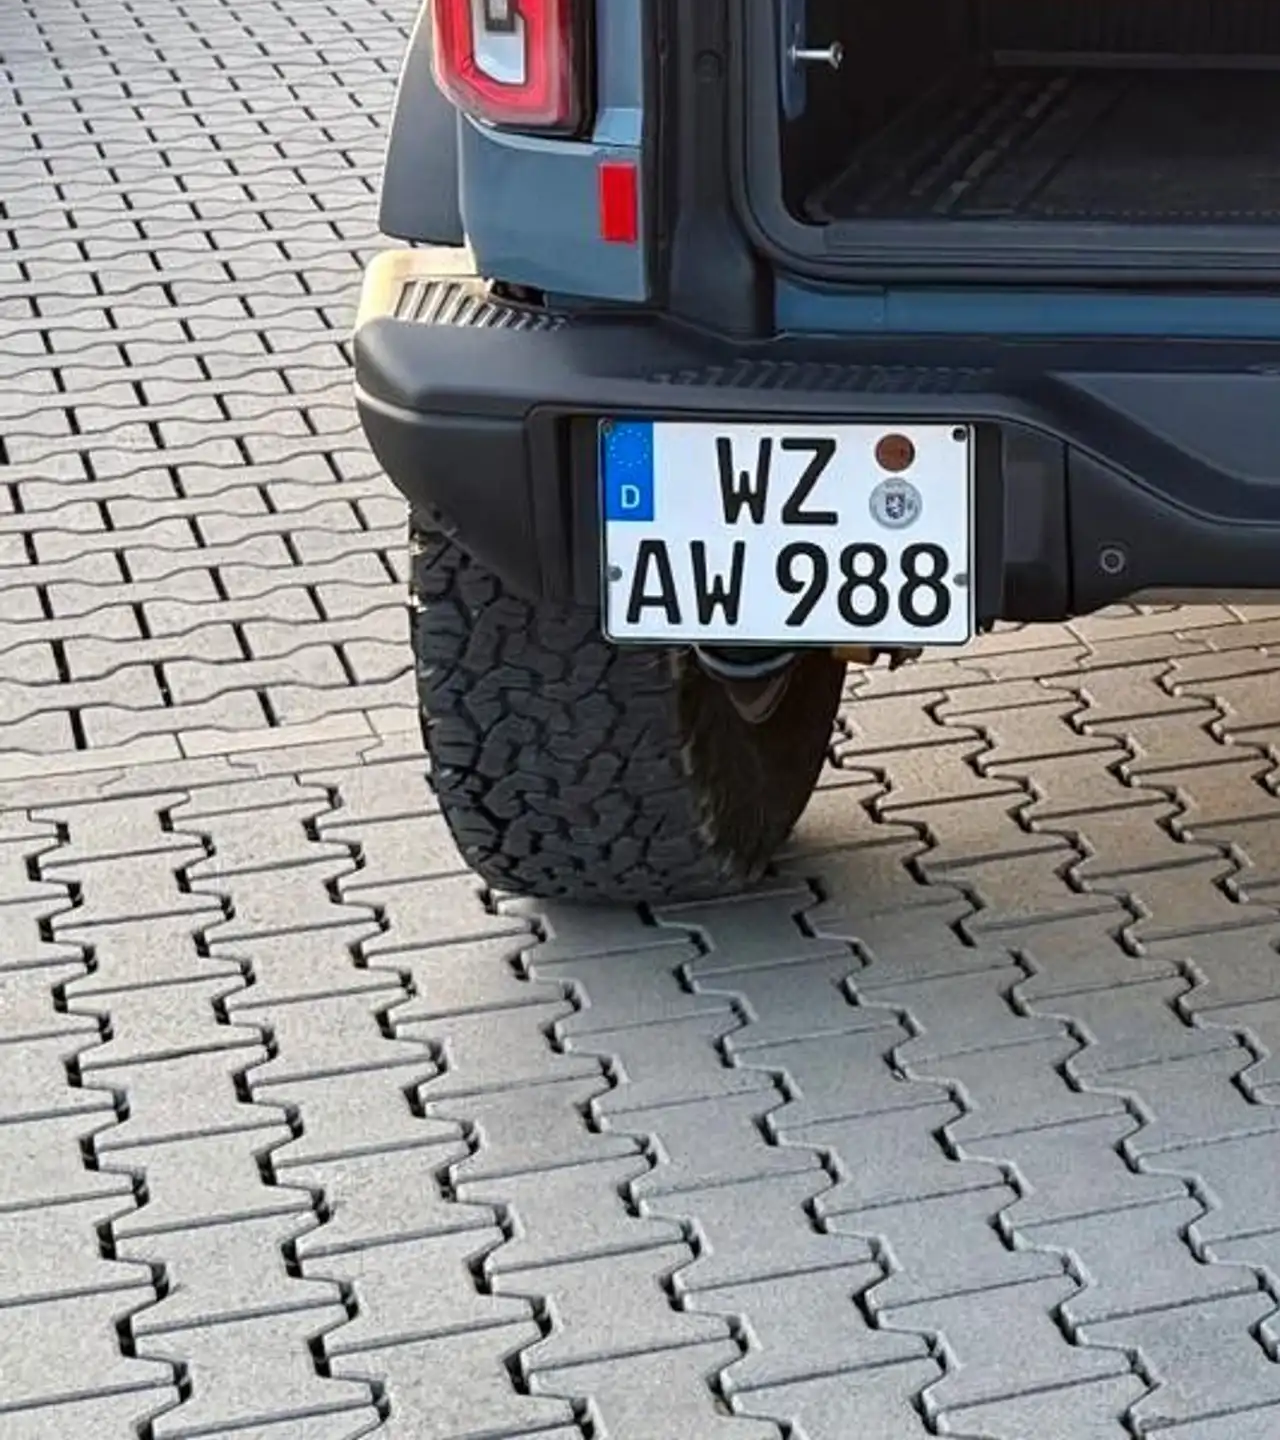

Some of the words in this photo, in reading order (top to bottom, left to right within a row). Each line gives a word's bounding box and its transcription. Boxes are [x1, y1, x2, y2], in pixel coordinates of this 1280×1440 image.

[621, 485, 640, 508] D
[716, 436, 839, 526] WZ
[626, 540, 746, 626] AW
[775, 542, 952, 627] 988
